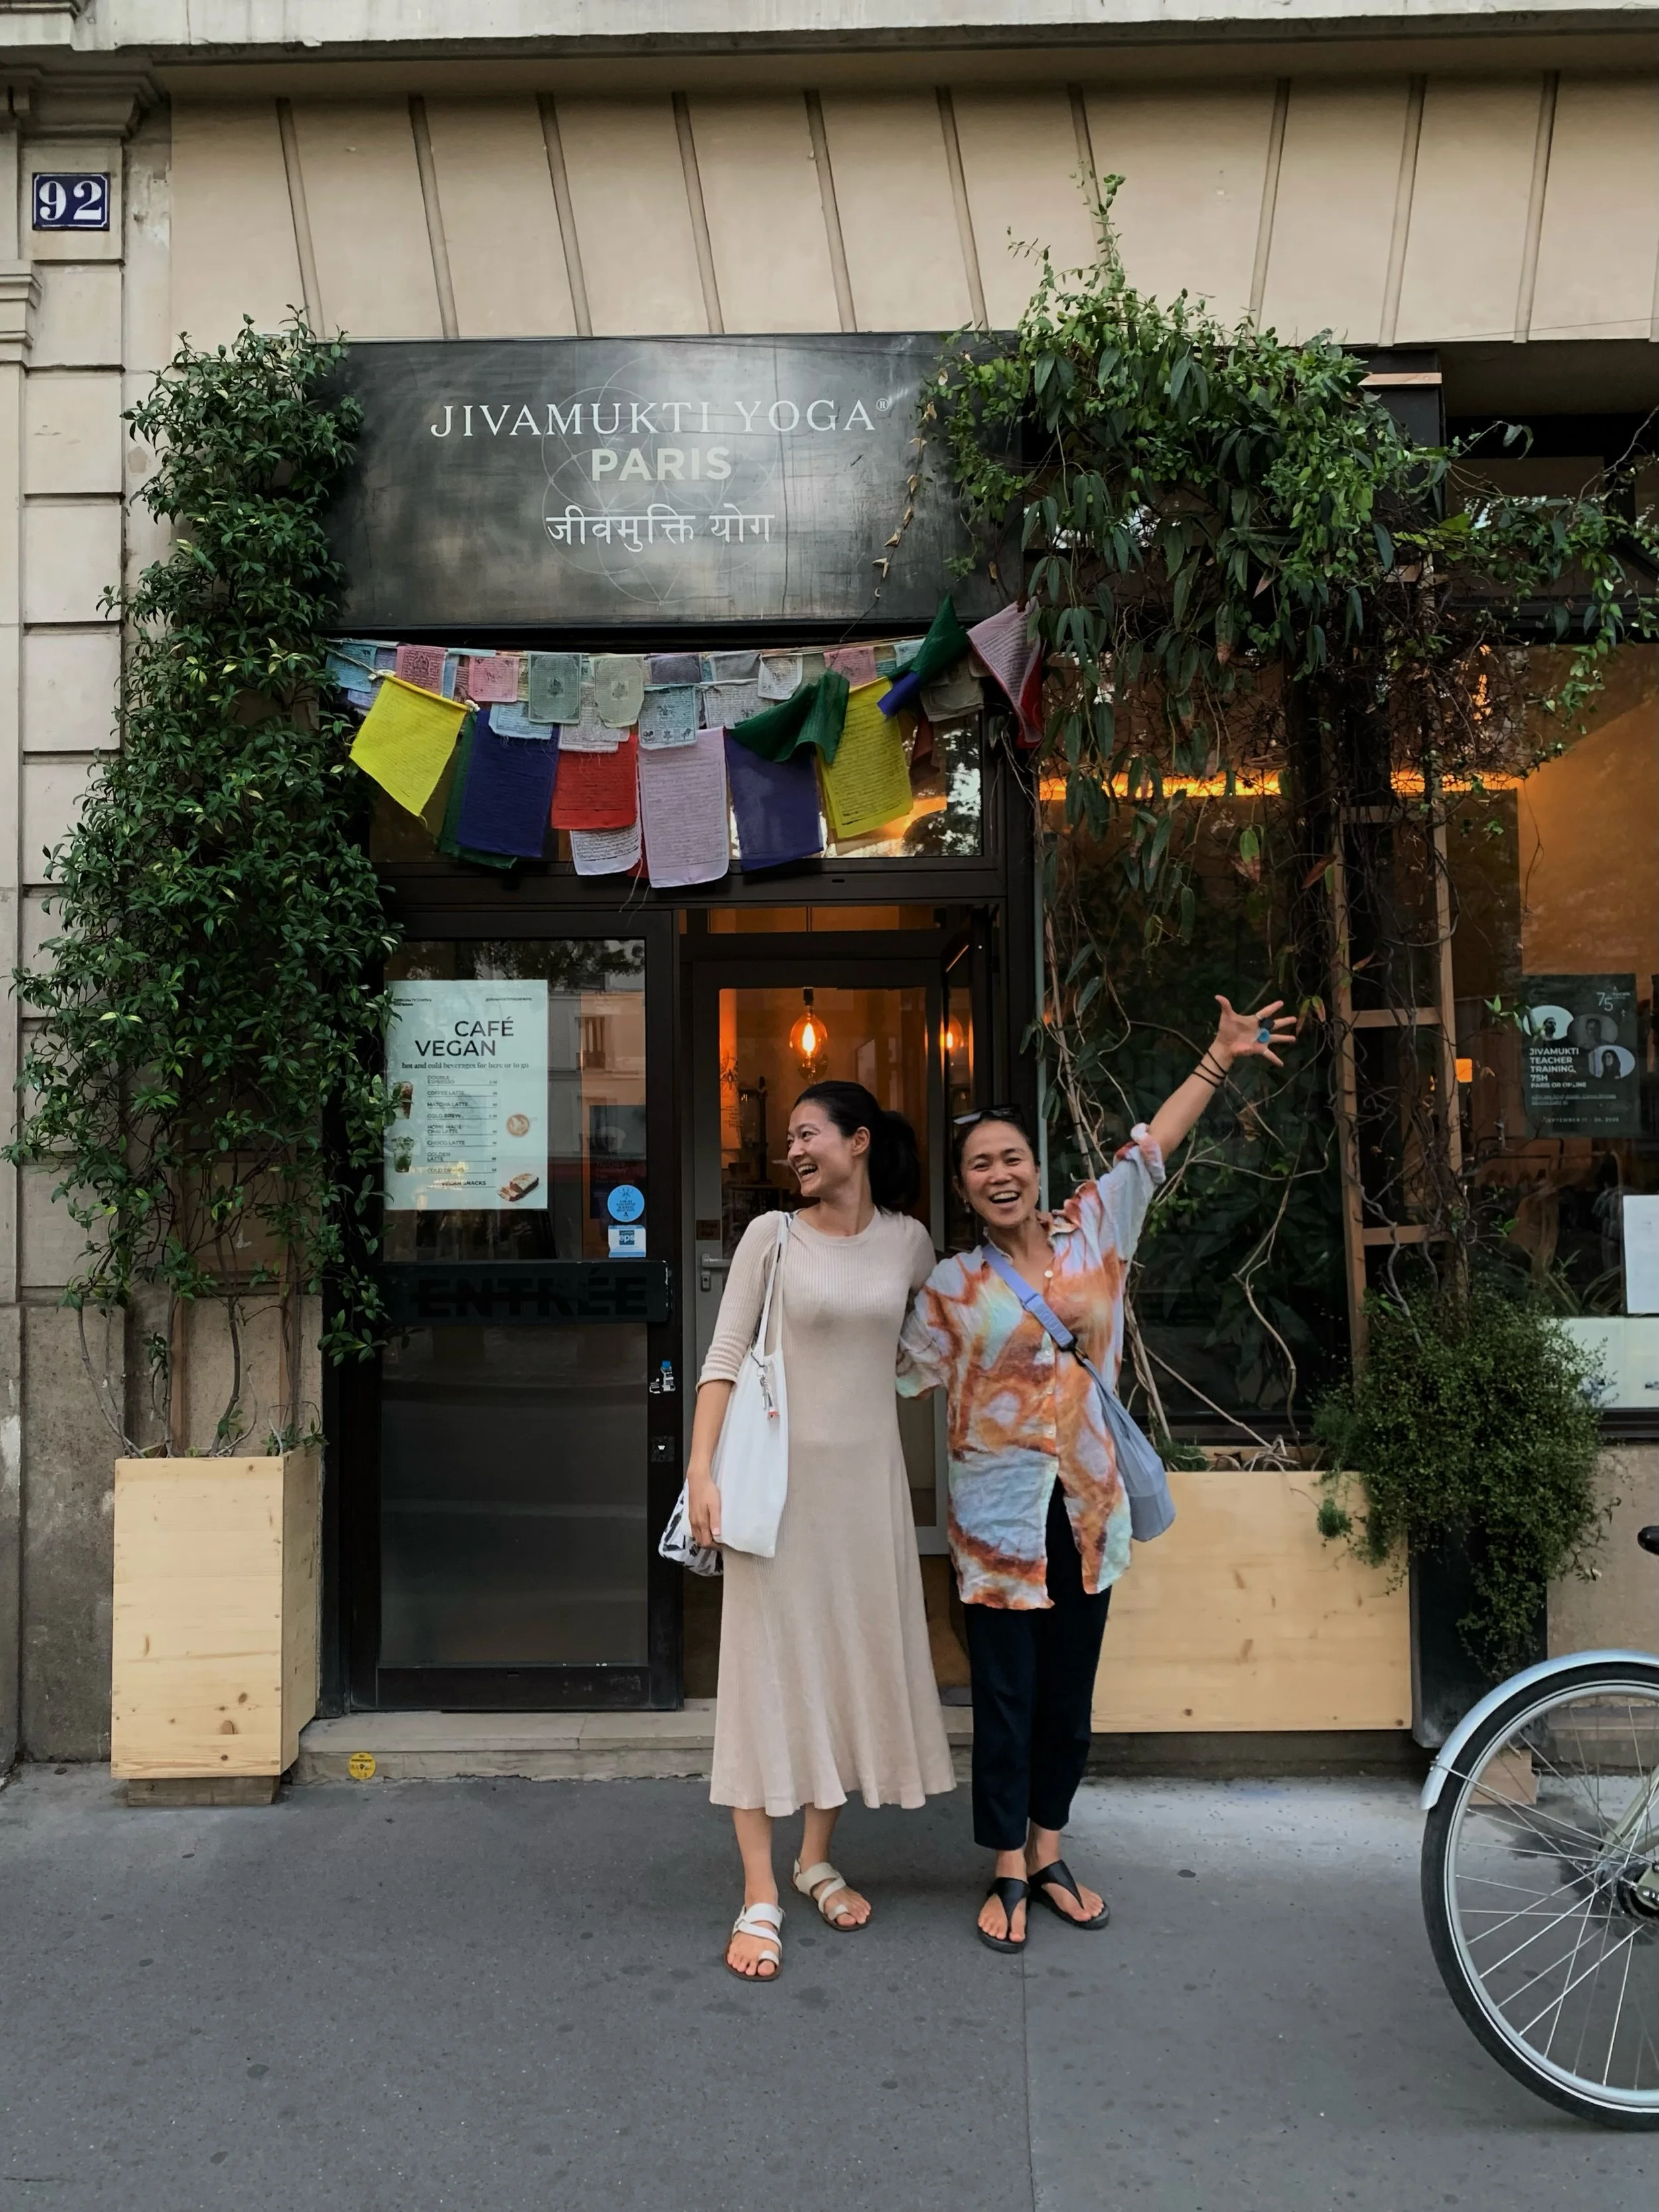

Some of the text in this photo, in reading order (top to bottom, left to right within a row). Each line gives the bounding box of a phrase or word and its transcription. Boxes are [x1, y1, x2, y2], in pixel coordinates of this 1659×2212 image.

[39, 181, 102, 220] 92
[431, 402, 711, 437] JIVAMUKTI
[591, 446, 732, 482] PARIS
[546, 502, 775, 552] जीवमुक्ति योग
[455, 1016, 514, 1037] CAFÉ
[415, 1040, 496, 1057] VEGAN
[417, 1266, 648, 1318] ENTRÉE
